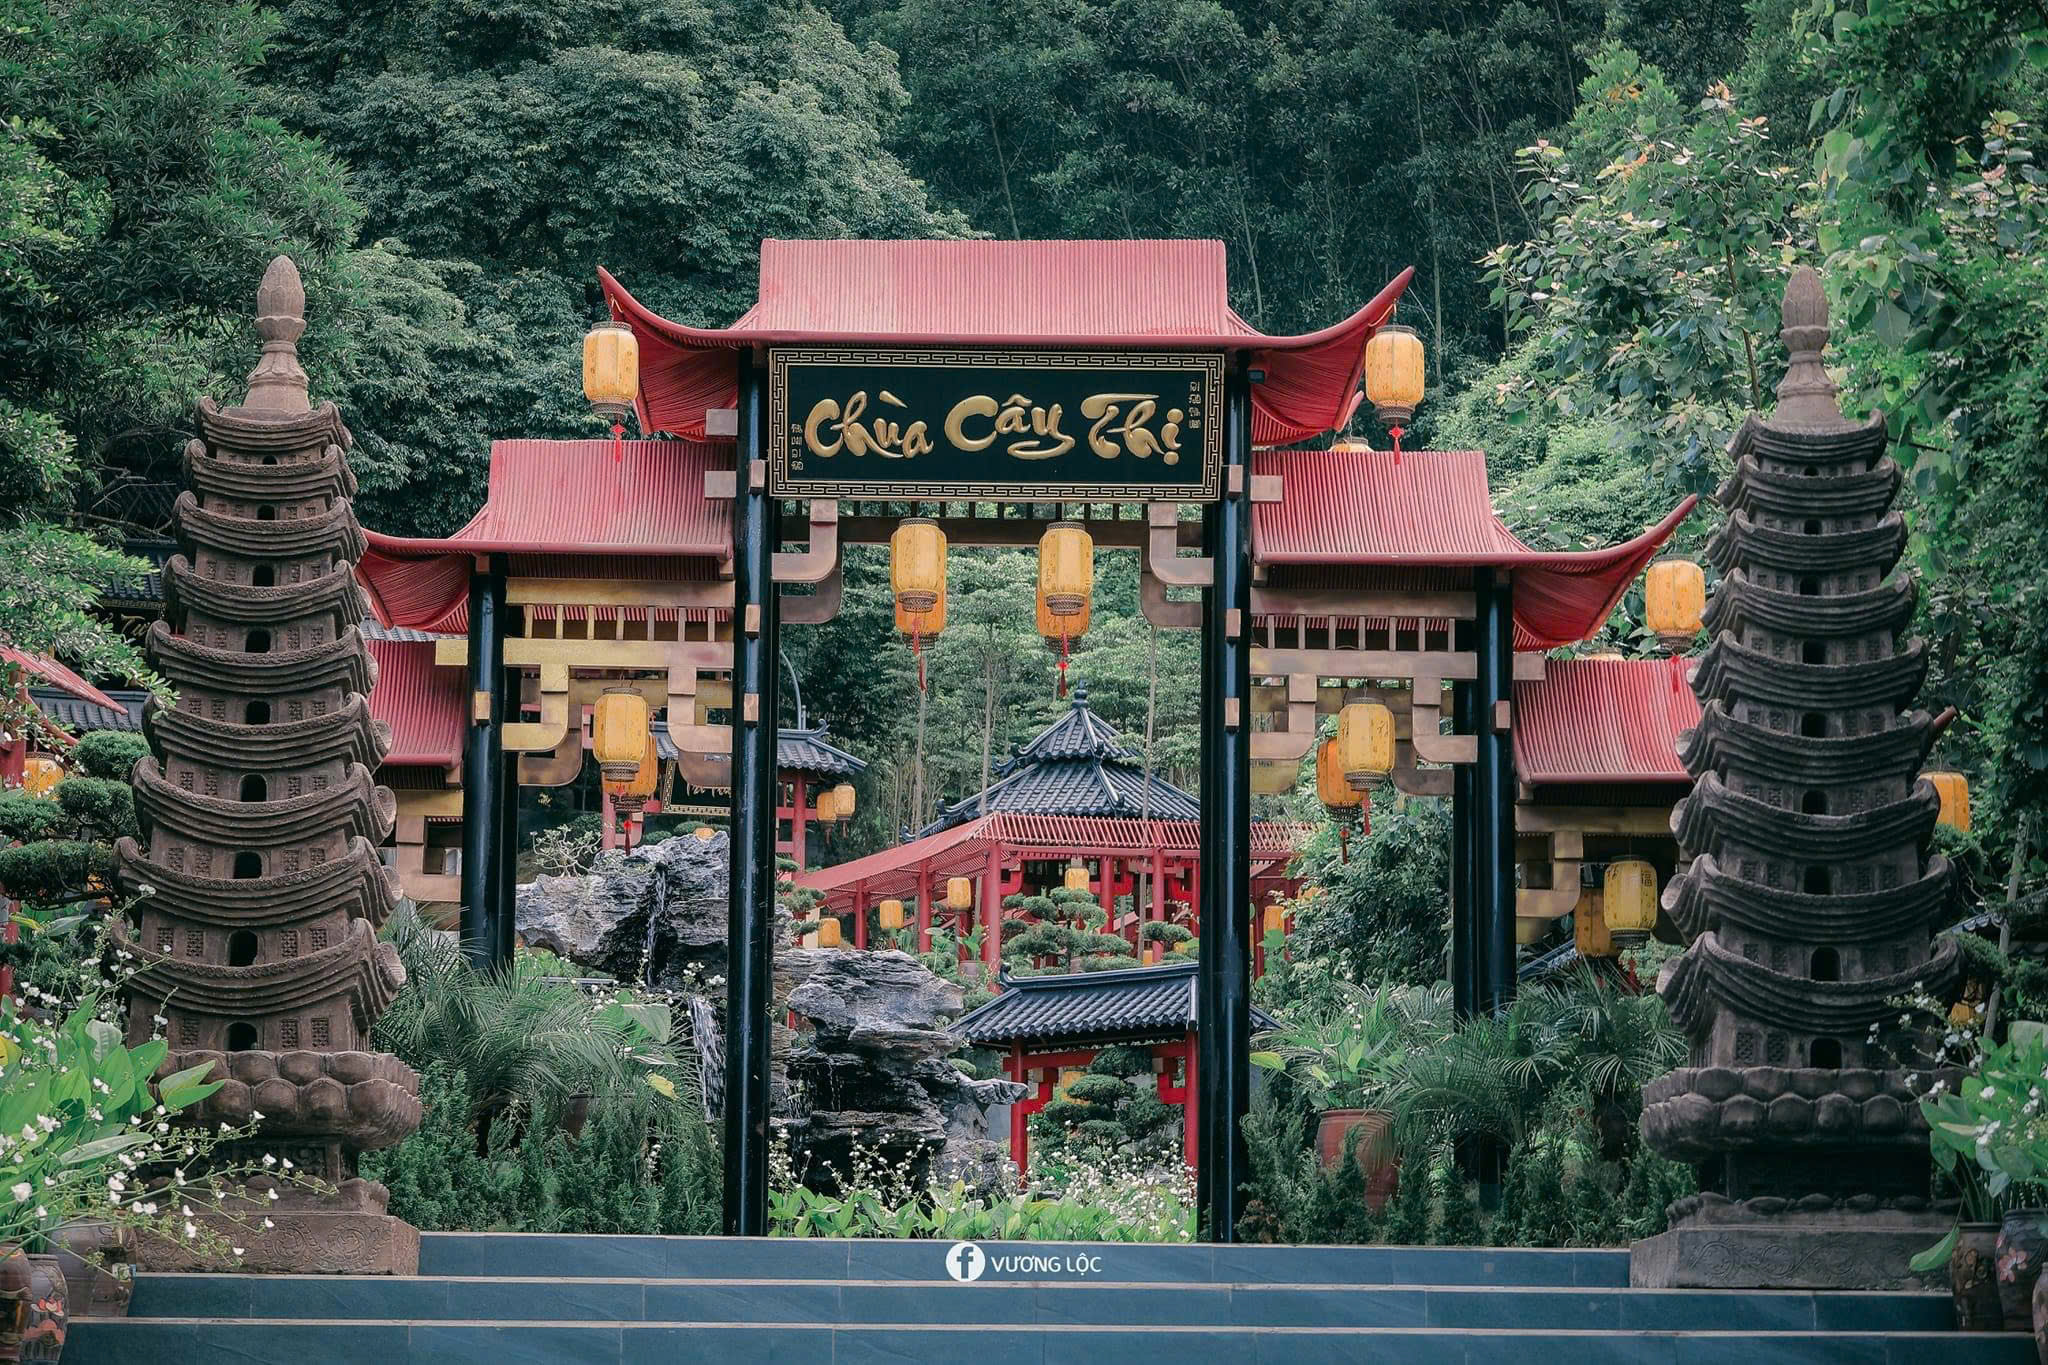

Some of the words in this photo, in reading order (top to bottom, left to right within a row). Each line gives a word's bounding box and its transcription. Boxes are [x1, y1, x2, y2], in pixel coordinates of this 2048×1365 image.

[804, 389, 934, 459] Chùa
[944, 393, 1076, 460] Cây
[1080, 392, 1185, 466] Thị
